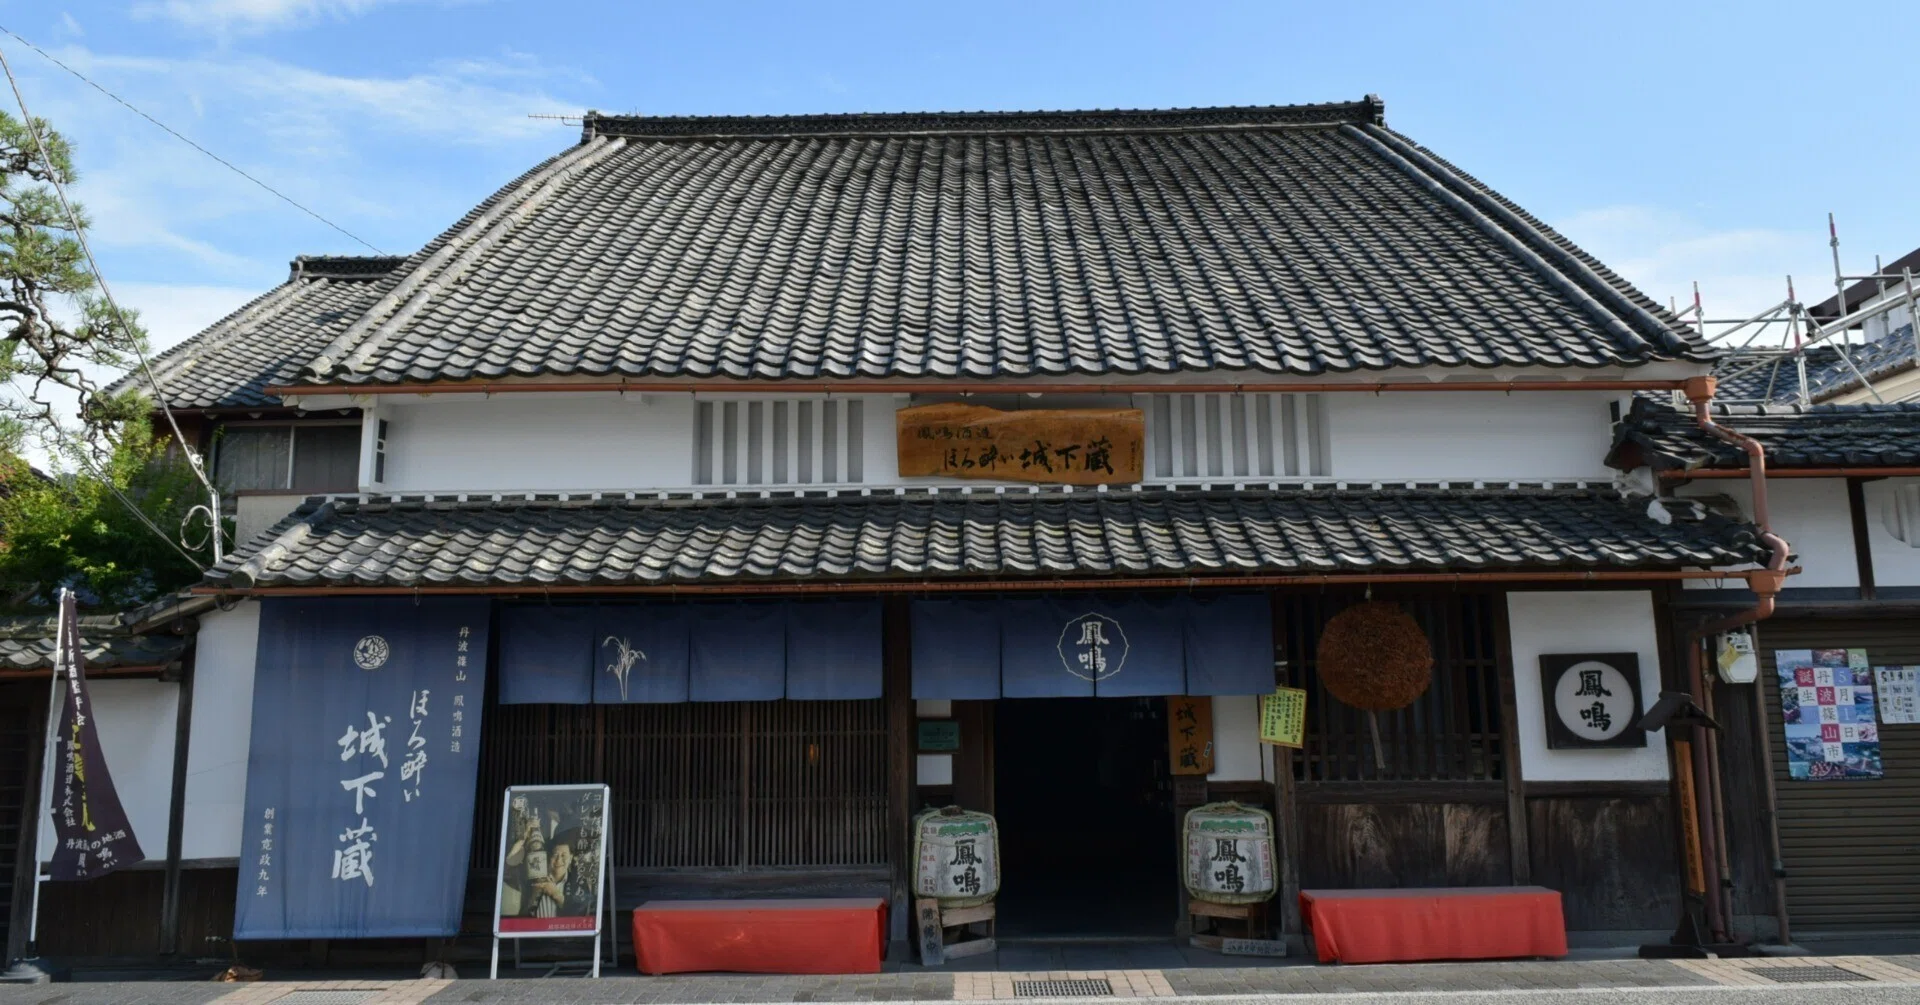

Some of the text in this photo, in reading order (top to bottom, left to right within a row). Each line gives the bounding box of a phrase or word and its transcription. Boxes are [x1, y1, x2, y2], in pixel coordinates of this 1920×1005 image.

[1075, 620, 1110, 673] 鳳鳴
[450, 626, 470, 753] 丹波篠山 鳳鳴酒造
[1574, 669, 1613, 733] 鳳鳴
[1798, 670, 1816, 703] 誕生
[1817, 670, 1840, 759] 丹波篠山市
[1838, 671, 1854, 738] 5月1日
[399, 689, 431, 803] ほろ酔い
[1175, 702, 1201, 769] 城下蔵
[331, 711, 393, 887] 城下蔵
[256, 807, 275, 898] 創業寛政九年
[949, 838, 983, 896] 鳳鳴
[1211, 838, 1247, 893] 鳳鳴
